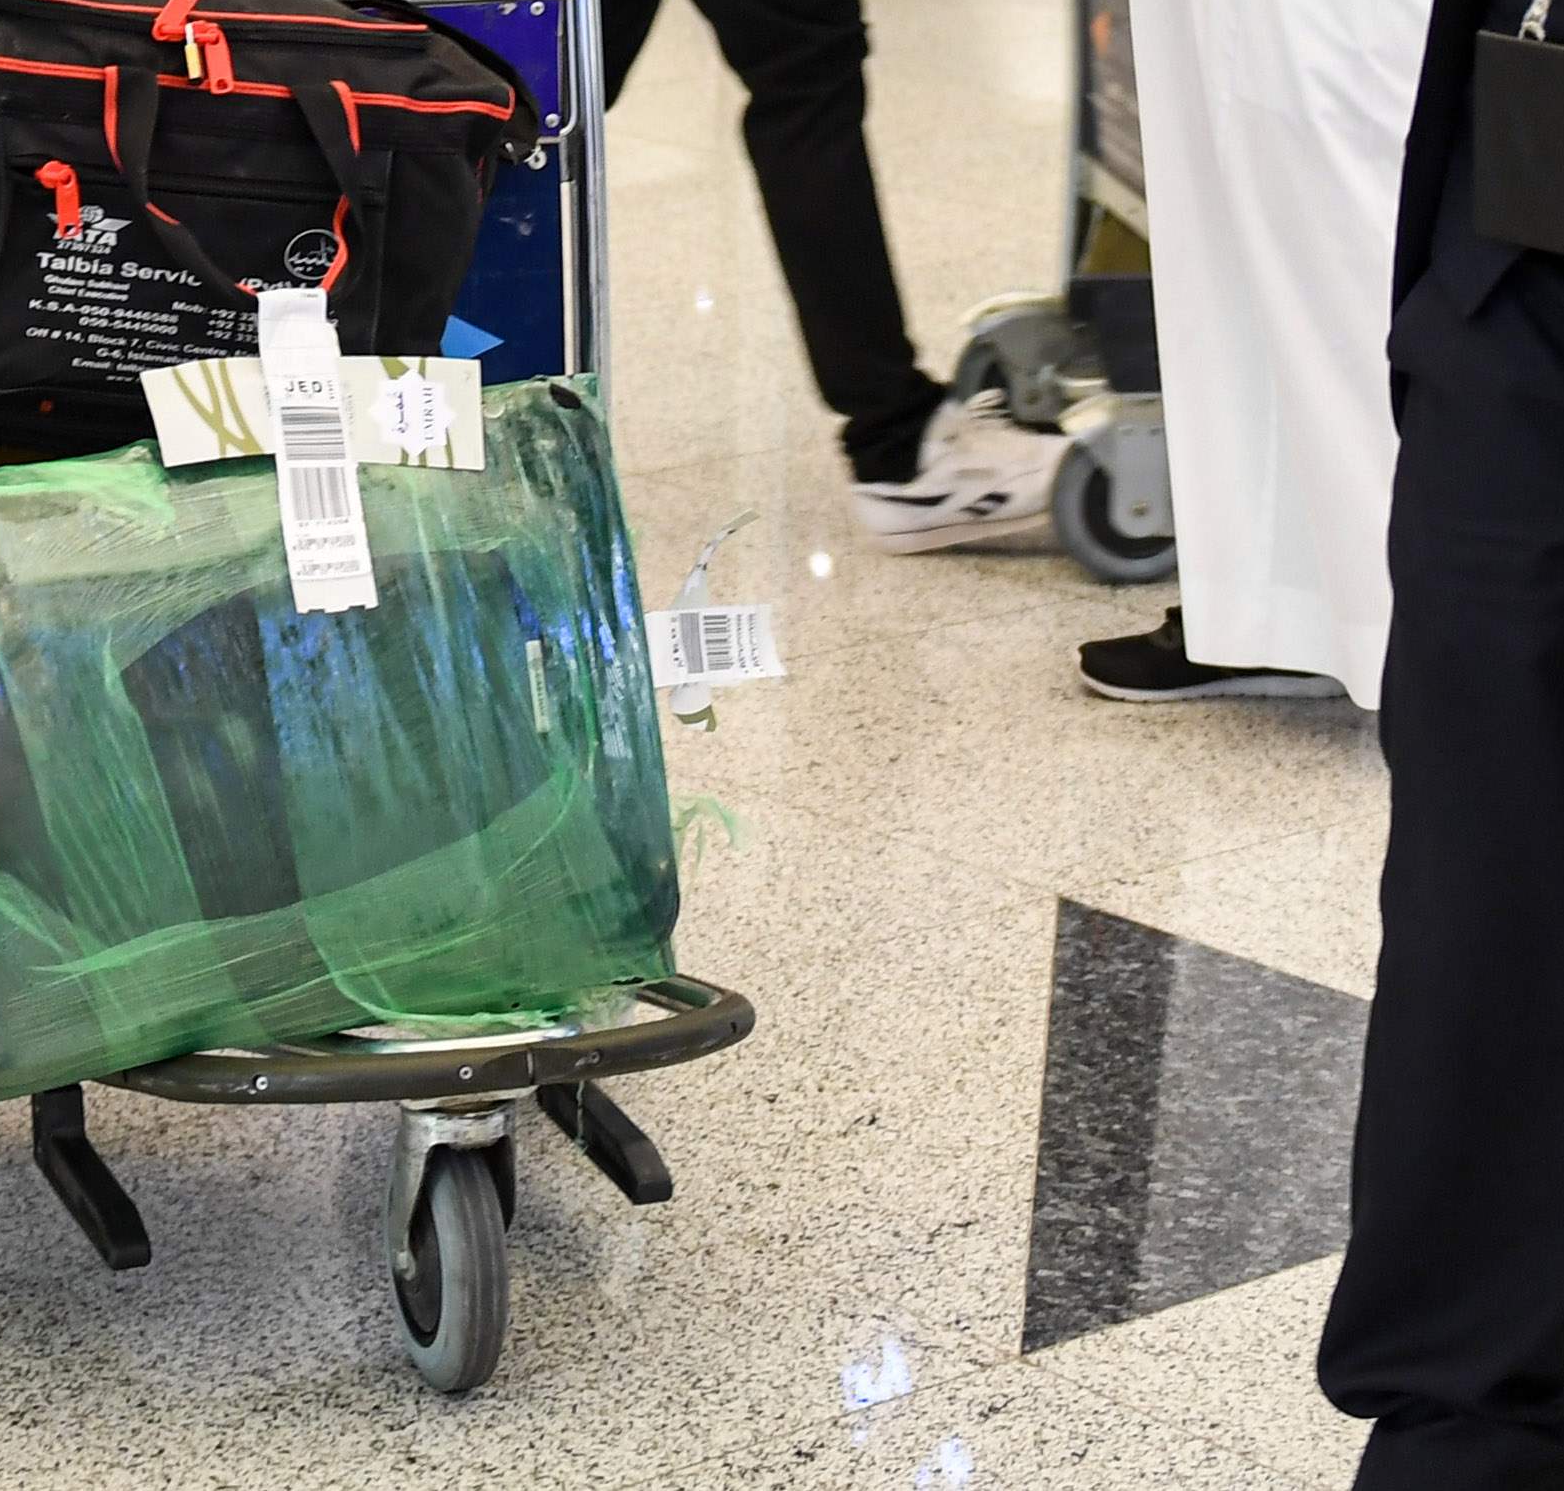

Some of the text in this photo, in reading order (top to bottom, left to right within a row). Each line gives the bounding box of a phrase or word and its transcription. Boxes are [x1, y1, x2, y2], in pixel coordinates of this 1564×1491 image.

[36, 252, 203, 287] Talbia Servic
[87, 333, 127, 346] Block
[284, 380, 323, 393] JED
